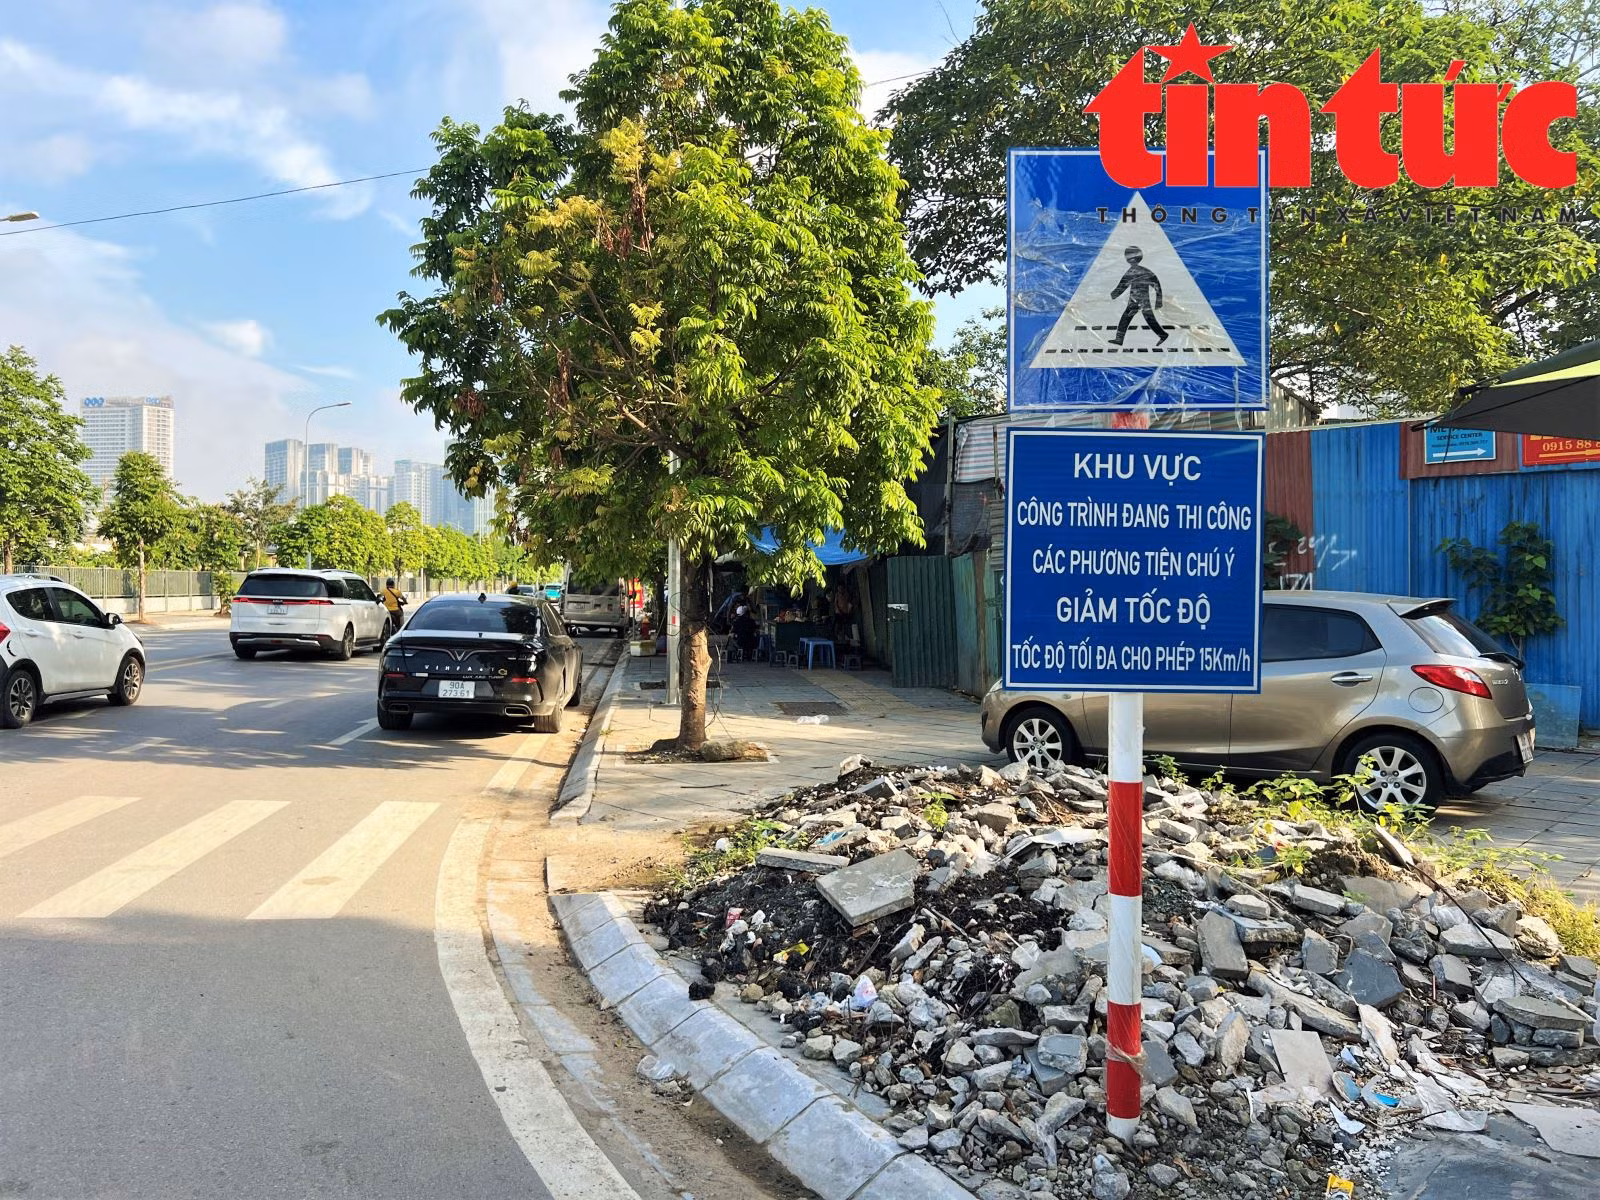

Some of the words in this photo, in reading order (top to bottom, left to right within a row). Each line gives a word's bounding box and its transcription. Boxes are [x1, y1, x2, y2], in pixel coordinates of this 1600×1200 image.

[1542, 440, 1573, 452] 0915
[1073, 452, 1134, 479] KHU
[1143, 453, 1202, 486] VỰC
[1017, 496, 1063, 527] CÔNG
[1067, 496, 1118, 528] TRÌNH
[1122, 503, 1170, 529] ĐANG
[1176, 504, 1203, 530] THI
[1206, 501, 1252, 531] CÔNG
[1032, 544, 1067, 574] CÁC
[1070, 548, 1141, 576] PHƯƠNG
[1145, 547, 1182, 580] TIỆN
[1186, 546, 1220, 577] CHÚ
[1225, 547, 1235, 577] Ý
[1056, 588, 1117, 624] GIẢM
[1125, 587, 1172, 624] TỐC
[1177, 593, 1211, 630] ĐỘ
[1012, 635, 1041, 670] TỐC
[1044, 640, 1065, 673] ĐỘ
[1068, 636, 1092, 670] TỐI
[1096, 645, 1118, 671] ĐA
[1121, 646, 1152, 671] CHO
[1155, 640, 1196, 672] PHÉP
[1199, 647, 1251, 673] 15Km/h
[449, 681, 465, 689] 90A
